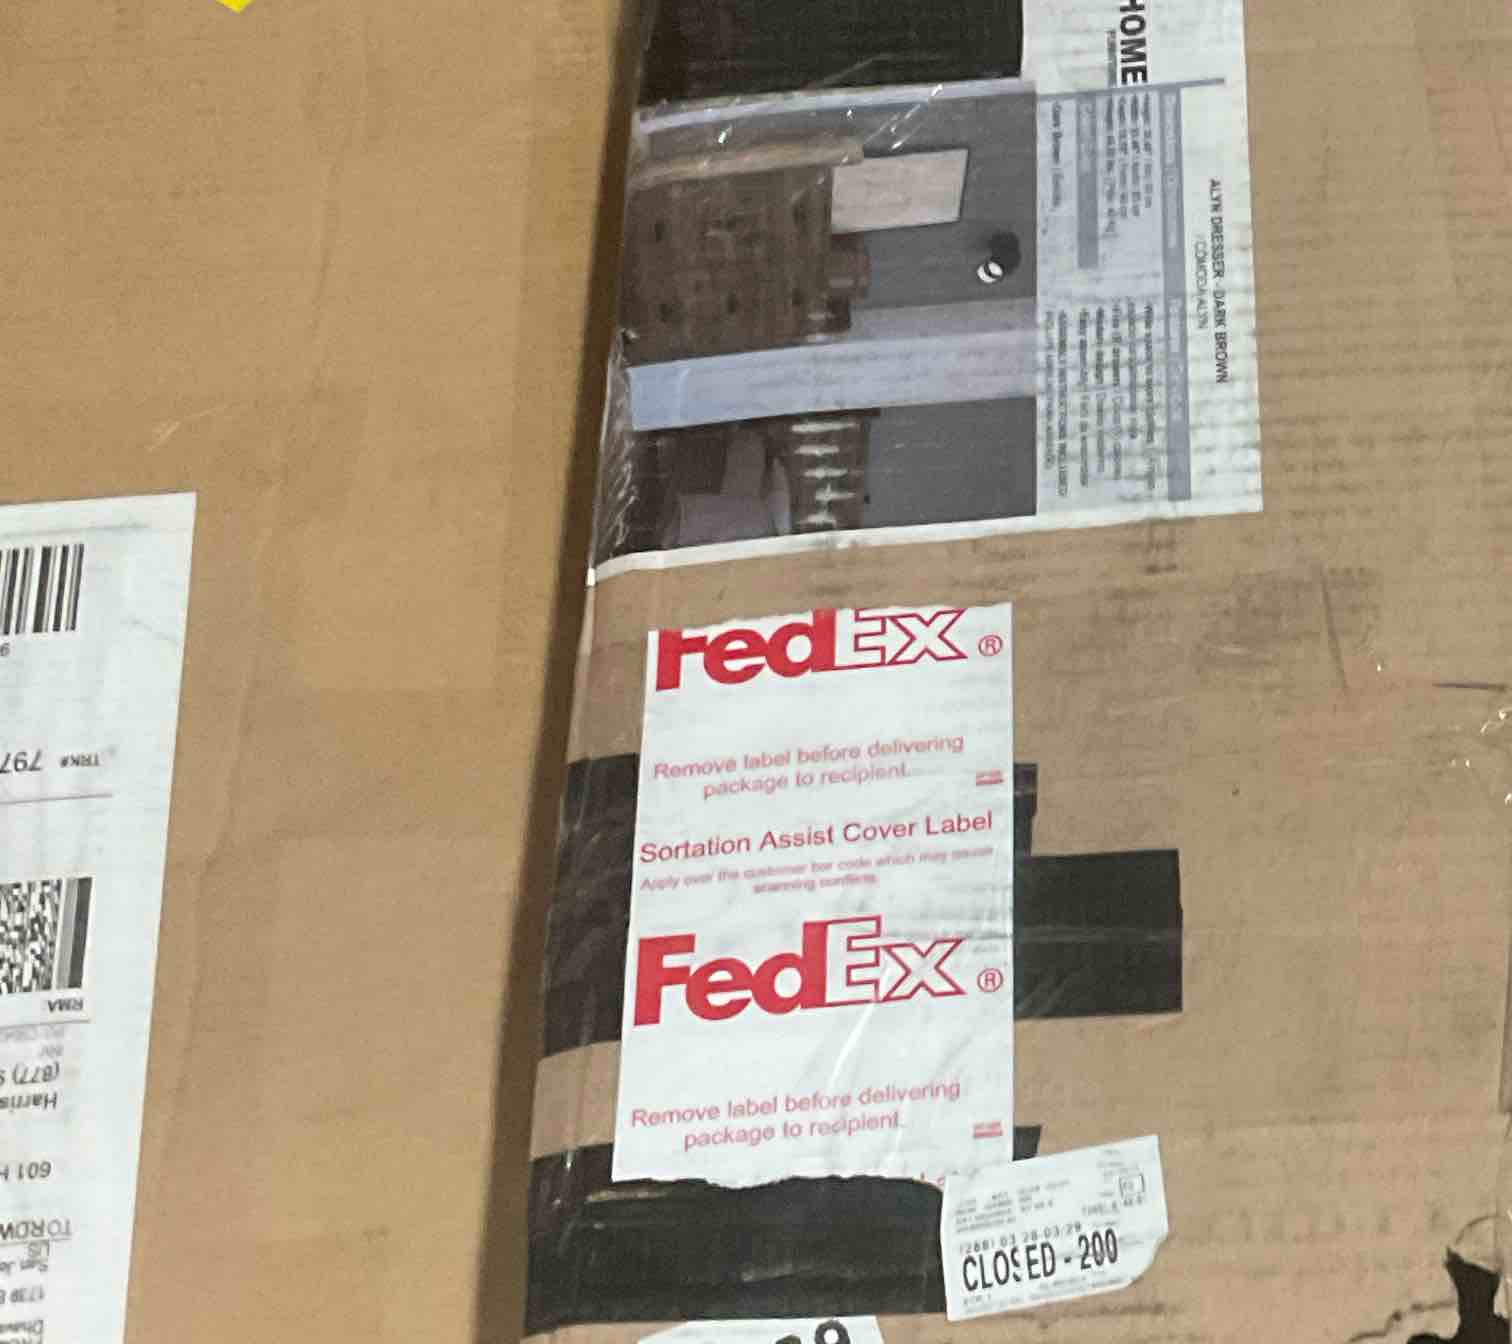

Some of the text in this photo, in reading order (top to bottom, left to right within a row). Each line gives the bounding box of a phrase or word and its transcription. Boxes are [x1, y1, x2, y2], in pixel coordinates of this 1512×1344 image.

[1210, 216, 1225, 279] DRESSER
[1213, 289, 1226, 328] DARK
[1215, 331, 1229, 385] BROWN
[656, 608, 968, 691] FedEx
[653, 734, 965, 780] Remove label before delivering
[703, 776, 789, 800] package
[796, 771, 815, 787] to
[640, 809, 993, 864] Sortation Assist Cover Label
[633, 915, 968, 1027] FedEx
[47, 997, 84, 1013] RMA
[631, 1076, 962, 1128] Remove label before delivering
[684, 1124, 776, 1153] package
[782, 1120, 803, 1139] to
[18, 1161, 52, 1180] 601
[962, 1241, 1057, 1292] CLOSED
[1078, 1227, 1120, 1271] 200
